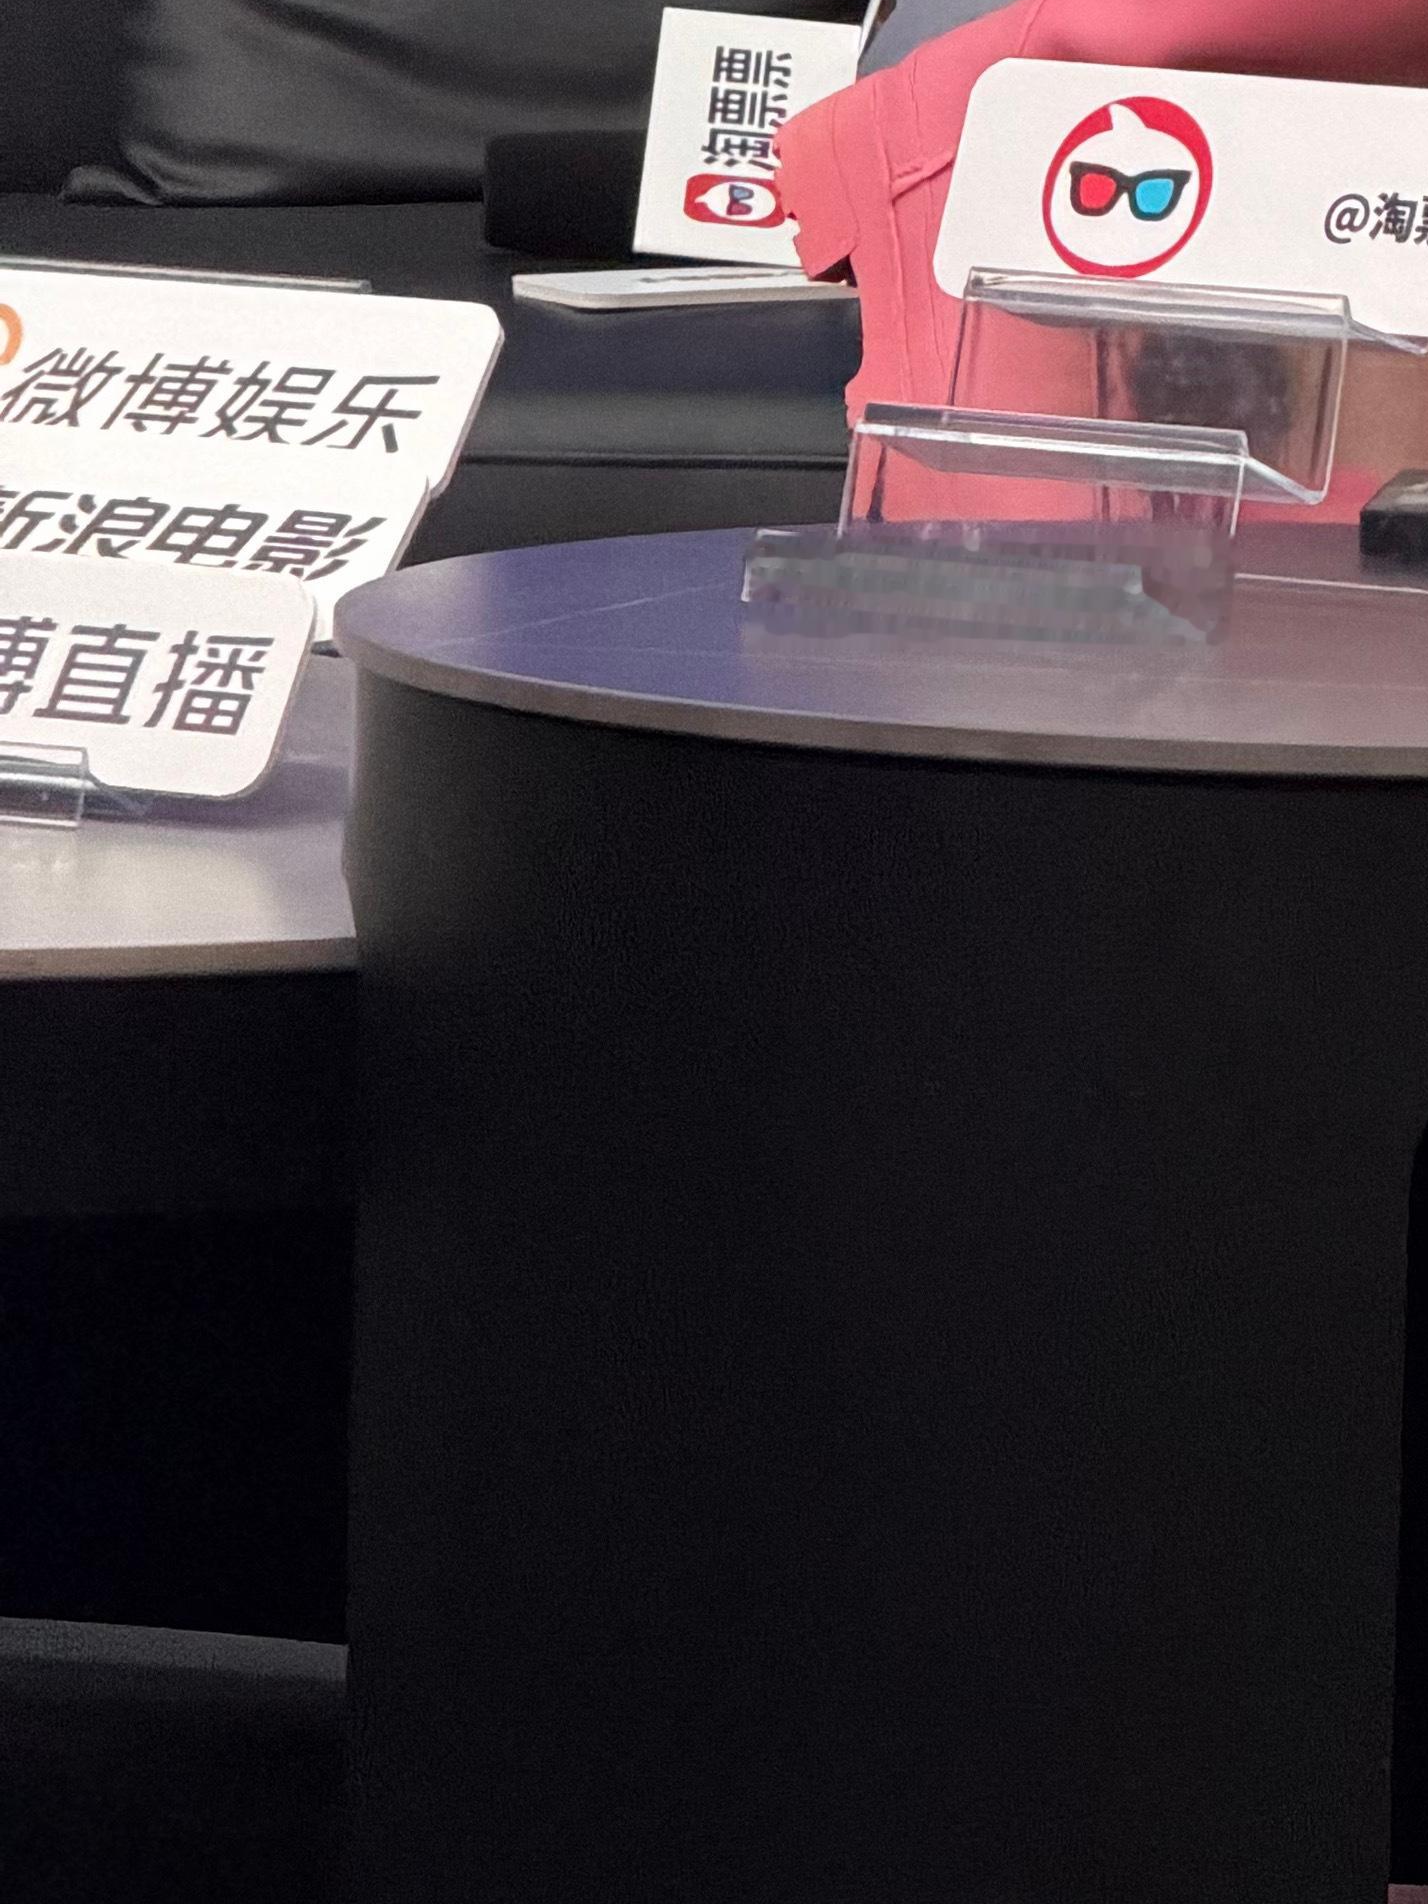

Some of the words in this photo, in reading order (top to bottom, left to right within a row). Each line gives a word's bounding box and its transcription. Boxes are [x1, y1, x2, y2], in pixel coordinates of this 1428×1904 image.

[701, 45, 793, 171] 淘票票
[0, 347, 441, 453] 微博娱乐
